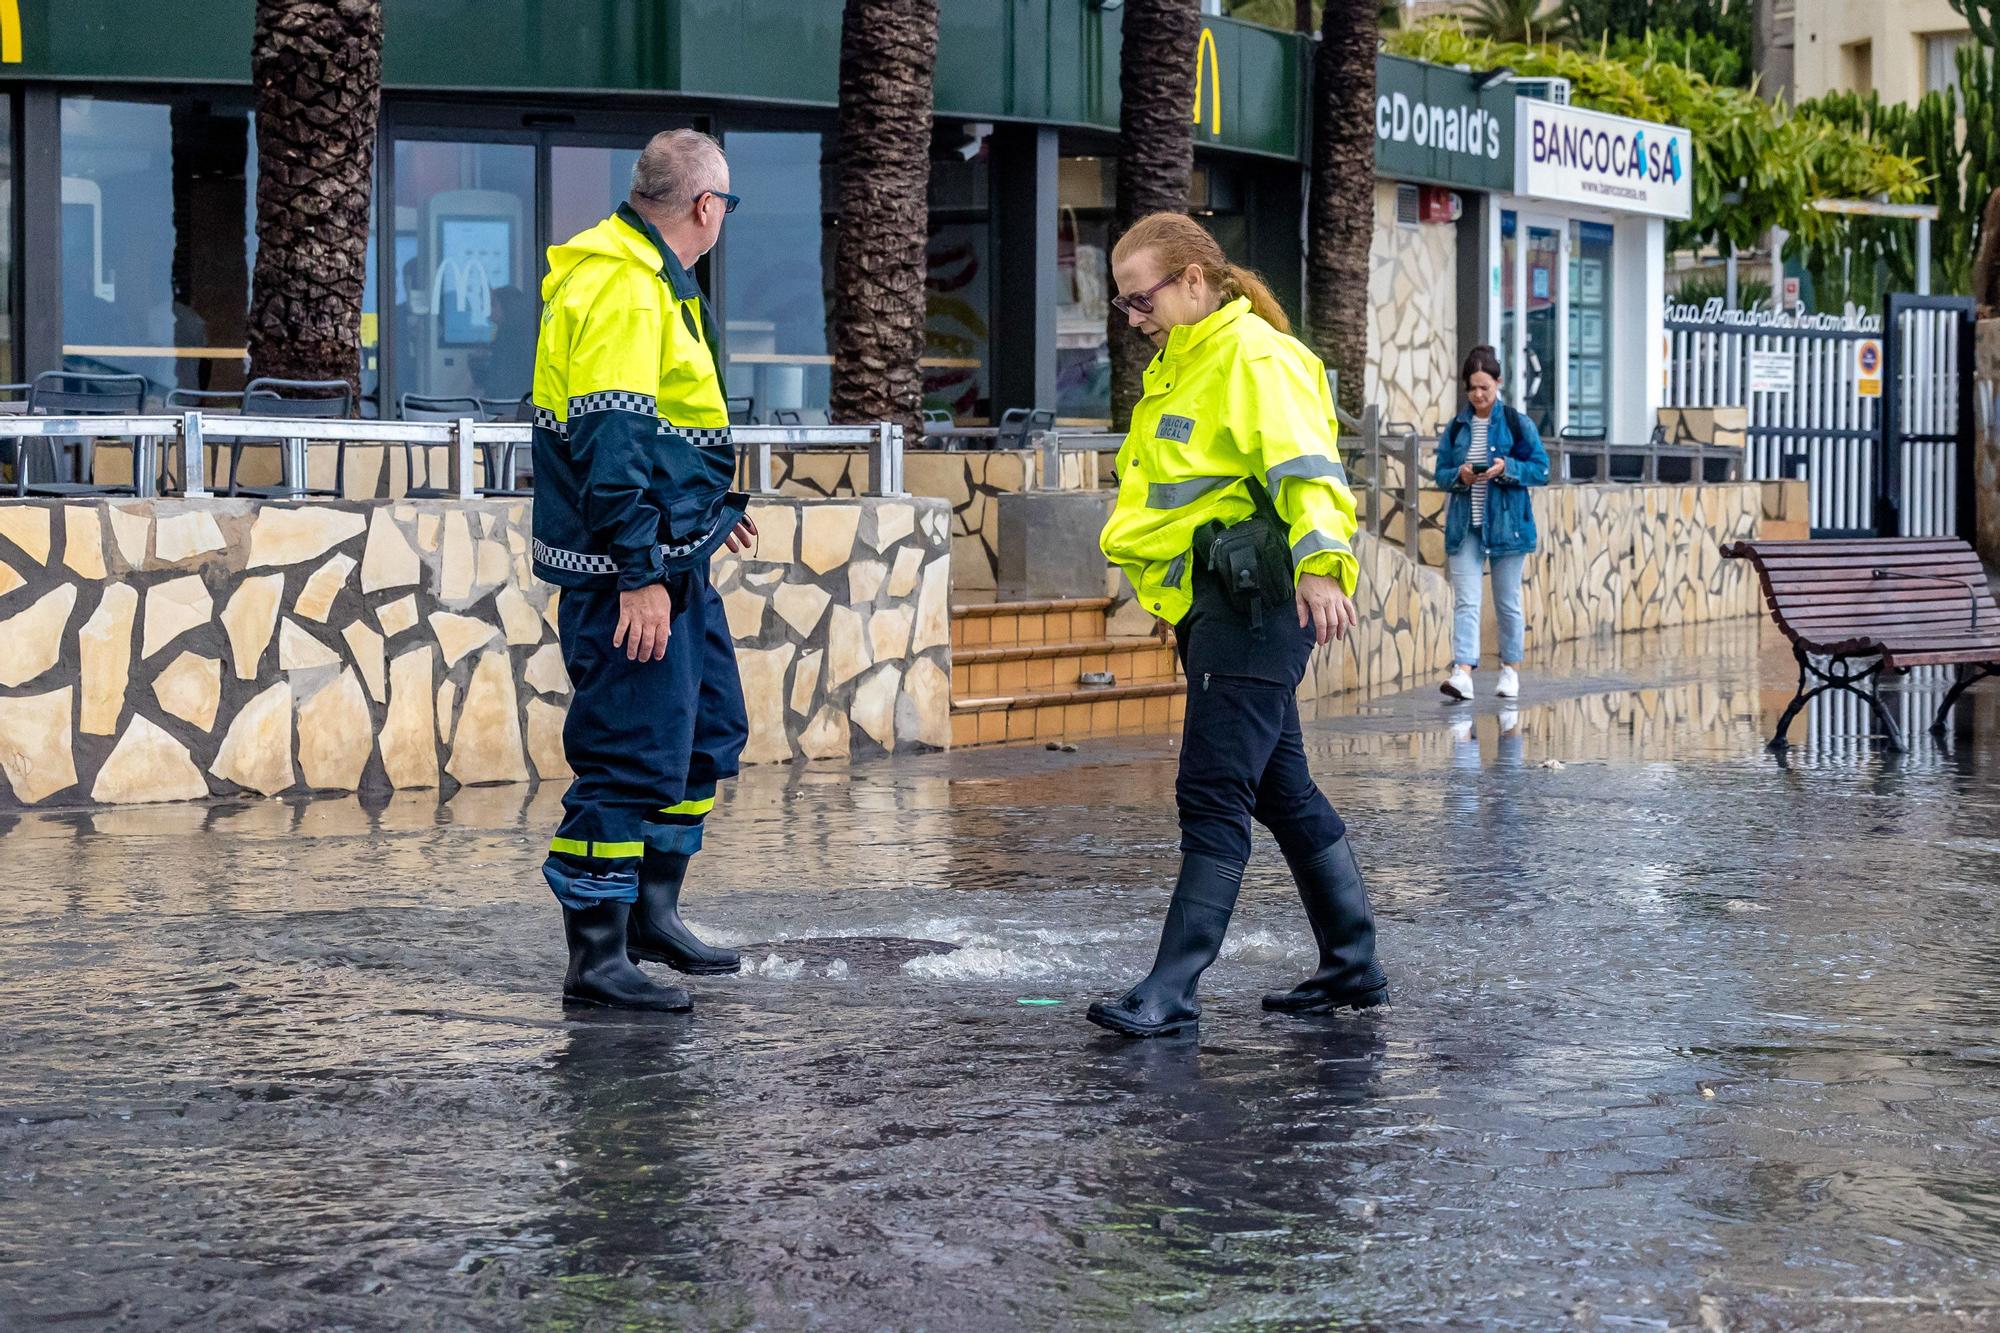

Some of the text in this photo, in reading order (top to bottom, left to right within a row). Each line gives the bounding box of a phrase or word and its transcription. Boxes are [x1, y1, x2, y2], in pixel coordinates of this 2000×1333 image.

[1376, 92, 1500, 159] cDonald's
[1533, 119, 1681, 185] BANCOCASA
[1160, 427, 1181, 438] LOCAL
